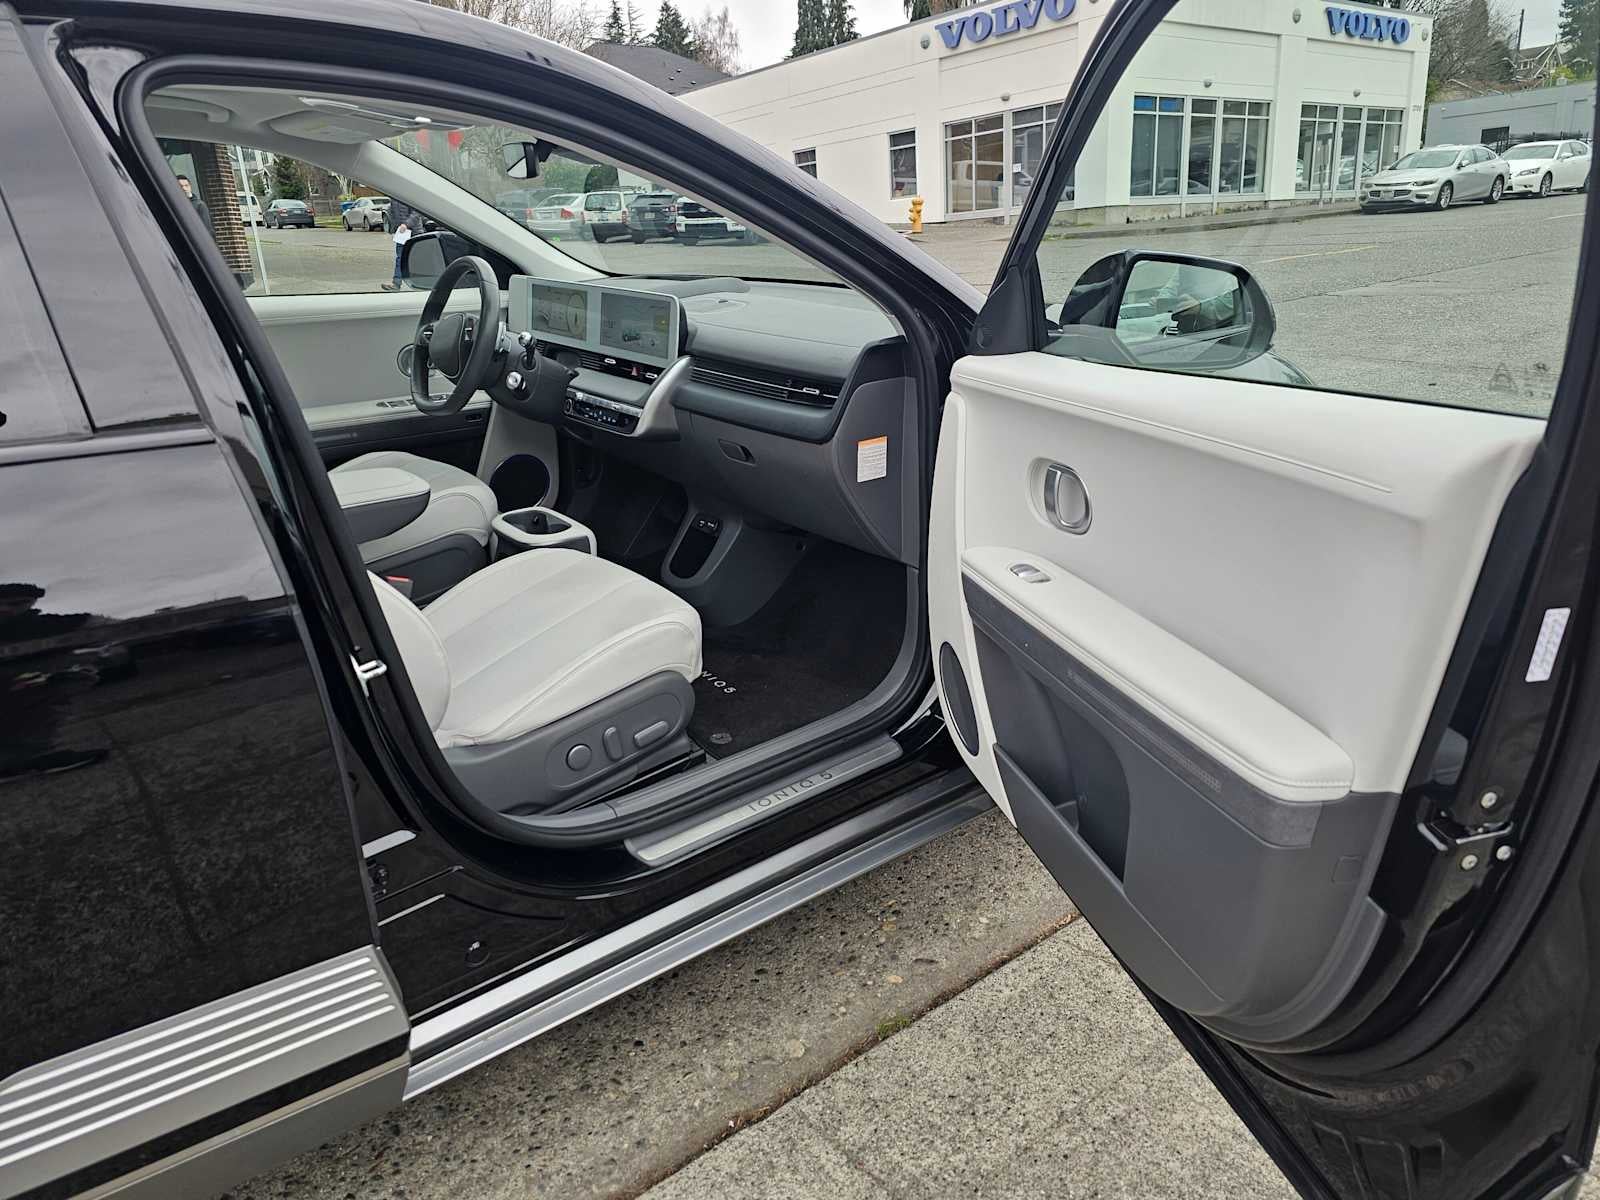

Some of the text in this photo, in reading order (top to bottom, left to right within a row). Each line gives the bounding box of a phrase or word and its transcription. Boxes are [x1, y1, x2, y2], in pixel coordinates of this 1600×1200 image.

[935, 0, 1076, 49] VOLVO
[1326, 7, 1410, 44] VOLVO
[748, 780, 815, 812] IONIQ
